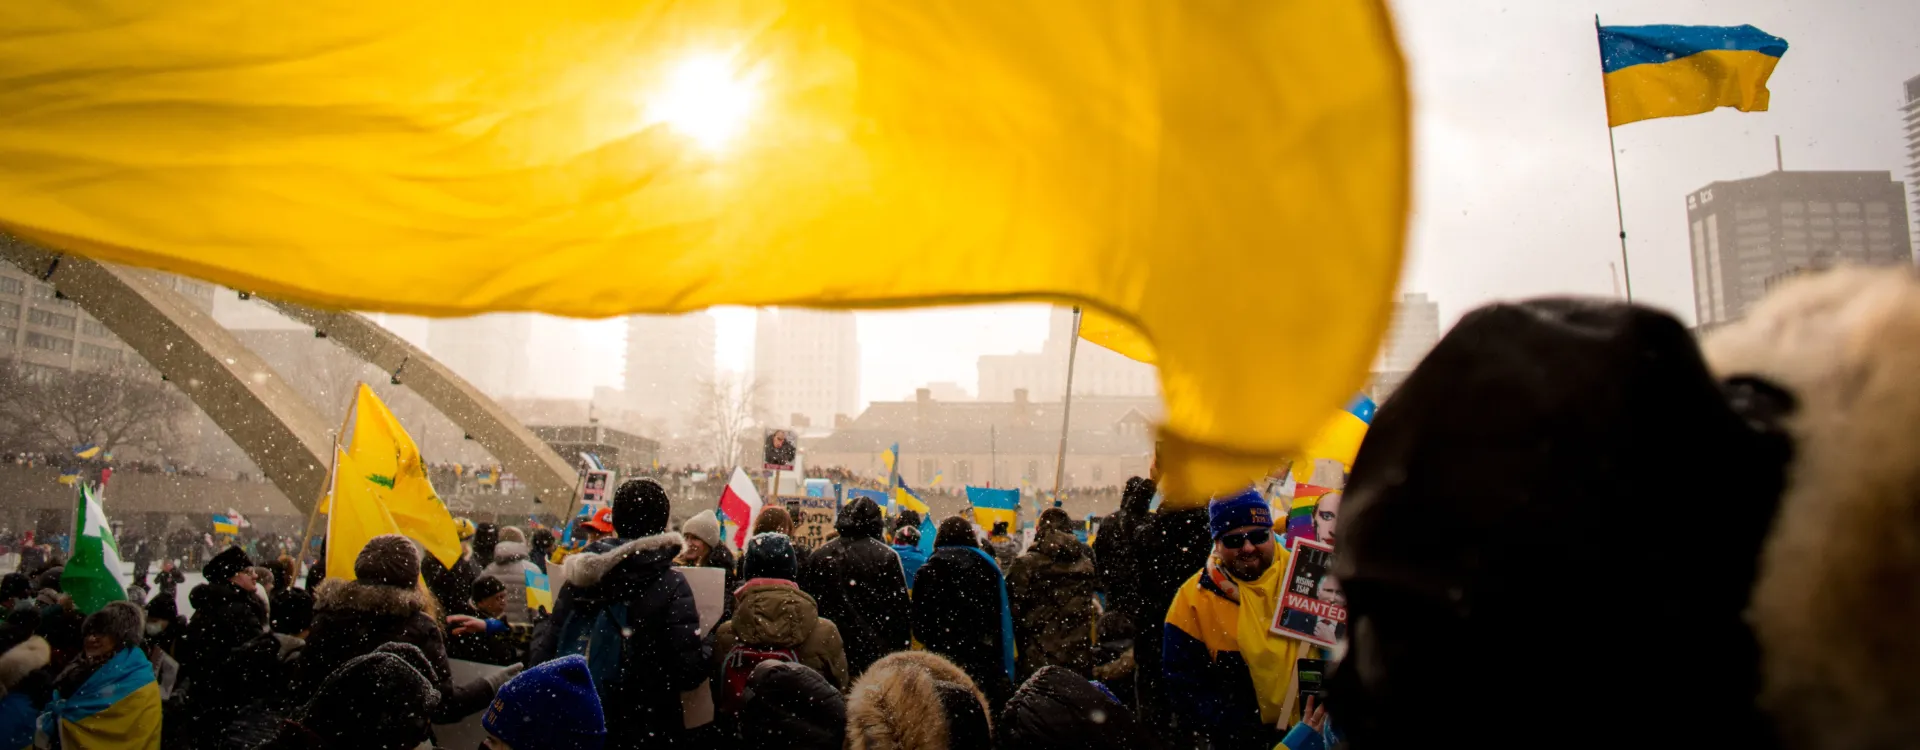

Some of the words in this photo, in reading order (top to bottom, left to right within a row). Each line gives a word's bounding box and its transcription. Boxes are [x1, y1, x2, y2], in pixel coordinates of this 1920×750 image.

[799, 511, 832, 526] PUTIN
[808, 525, 822, 536] IS
[1296, 575, 1315, 588] RISING
[1296, 584, 1310, 595] TSAR
[1288, 594, 1347, 620] WANTED
